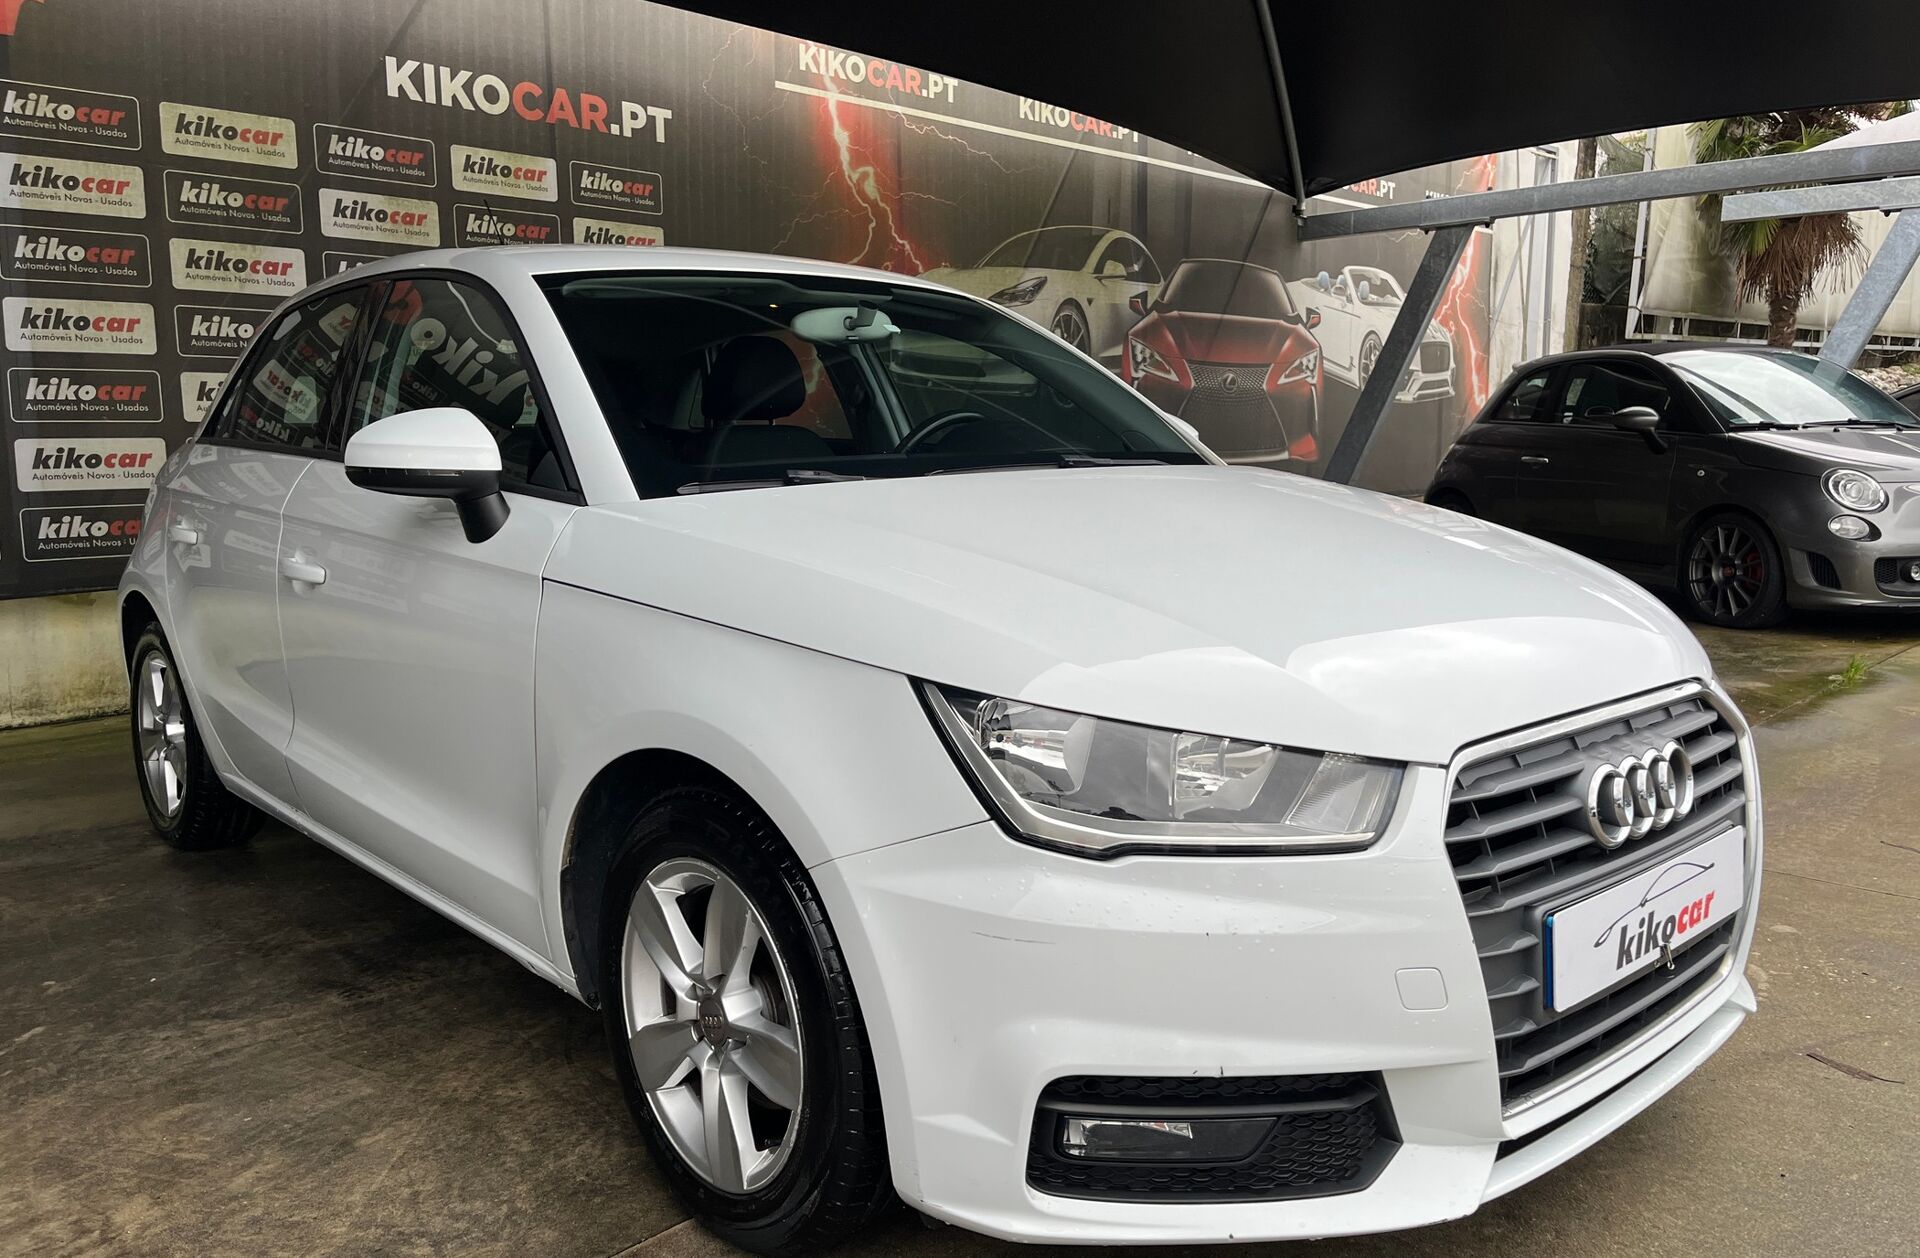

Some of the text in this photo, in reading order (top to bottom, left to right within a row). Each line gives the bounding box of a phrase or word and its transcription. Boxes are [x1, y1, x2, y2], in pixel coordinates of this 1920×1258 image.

[798, 43, 958, 103] KIKOCAR.PT
[3, 90, 126, 126] kikocar
[384, 55, 672, 144] KIKOCAR.PT
[59, 122, 88, 134] Novos
[95, 126, 128, 139] Usados
[175, 113, 284, 146] kikocar
[224, 143, 250, 153] Novos
[256, 148, 286, 158] Usados
[328, 134, 424, 166] kikocar
[9, 163, 131, 195] kikocar
[371, 162, 395, 173] Novos
[400, 166, 426, 177] Usados
[463, 154, 548, 182] kikocar
[500, 180, 521, 189] Novos
[526, 183, 549, 193] Usados
[580, 170, 653, 196] kikocar
[1343, 179, 1396, 200] CAR.PT
[64, 194, 93, 204] Novos
[100, 196, 133, 207] Usados
[180, 181, 288, 212] kikocar
[229, 209, 255, 219] Novos
[261, 212, 290, 223] Usados
[333, 198, 428, 226] kikocar
[376, 225, 399, 234] Novos
[404, 227, 430, 237] Usados
[466, 213, 550, 239] kikocar
[584, 226, 656, 246] kikocar
[14, 235, 135, 265] kikocar
[69, 263, 98, 274] Novos
[105, 265, 138, 277] Usados
[185, 248, 293, 277] kikocar
[235, 276, 260, 285] Novos
[267, 278, 295, 288] Usados
[20, 306, 141, 333] kikocar
[191, 315, 258, 339] kiko
[75, 335, 104, 343] Novos
[111, 336, 143, 345] Usados
[25, 377, 147, 401] kikocar
[81, 403, 109, 412] Novos
[117, 403, 149, 412] Usados
[32, 447, 153, 470] kikocar
[87, 471, 115, 480] Novos
[123, 470, 155, 480] Usados
[38, 515, 142, 539] kikoca
[93, 538, 122, 548] Novos
[1616, 890, 1715, 971] kikocar
